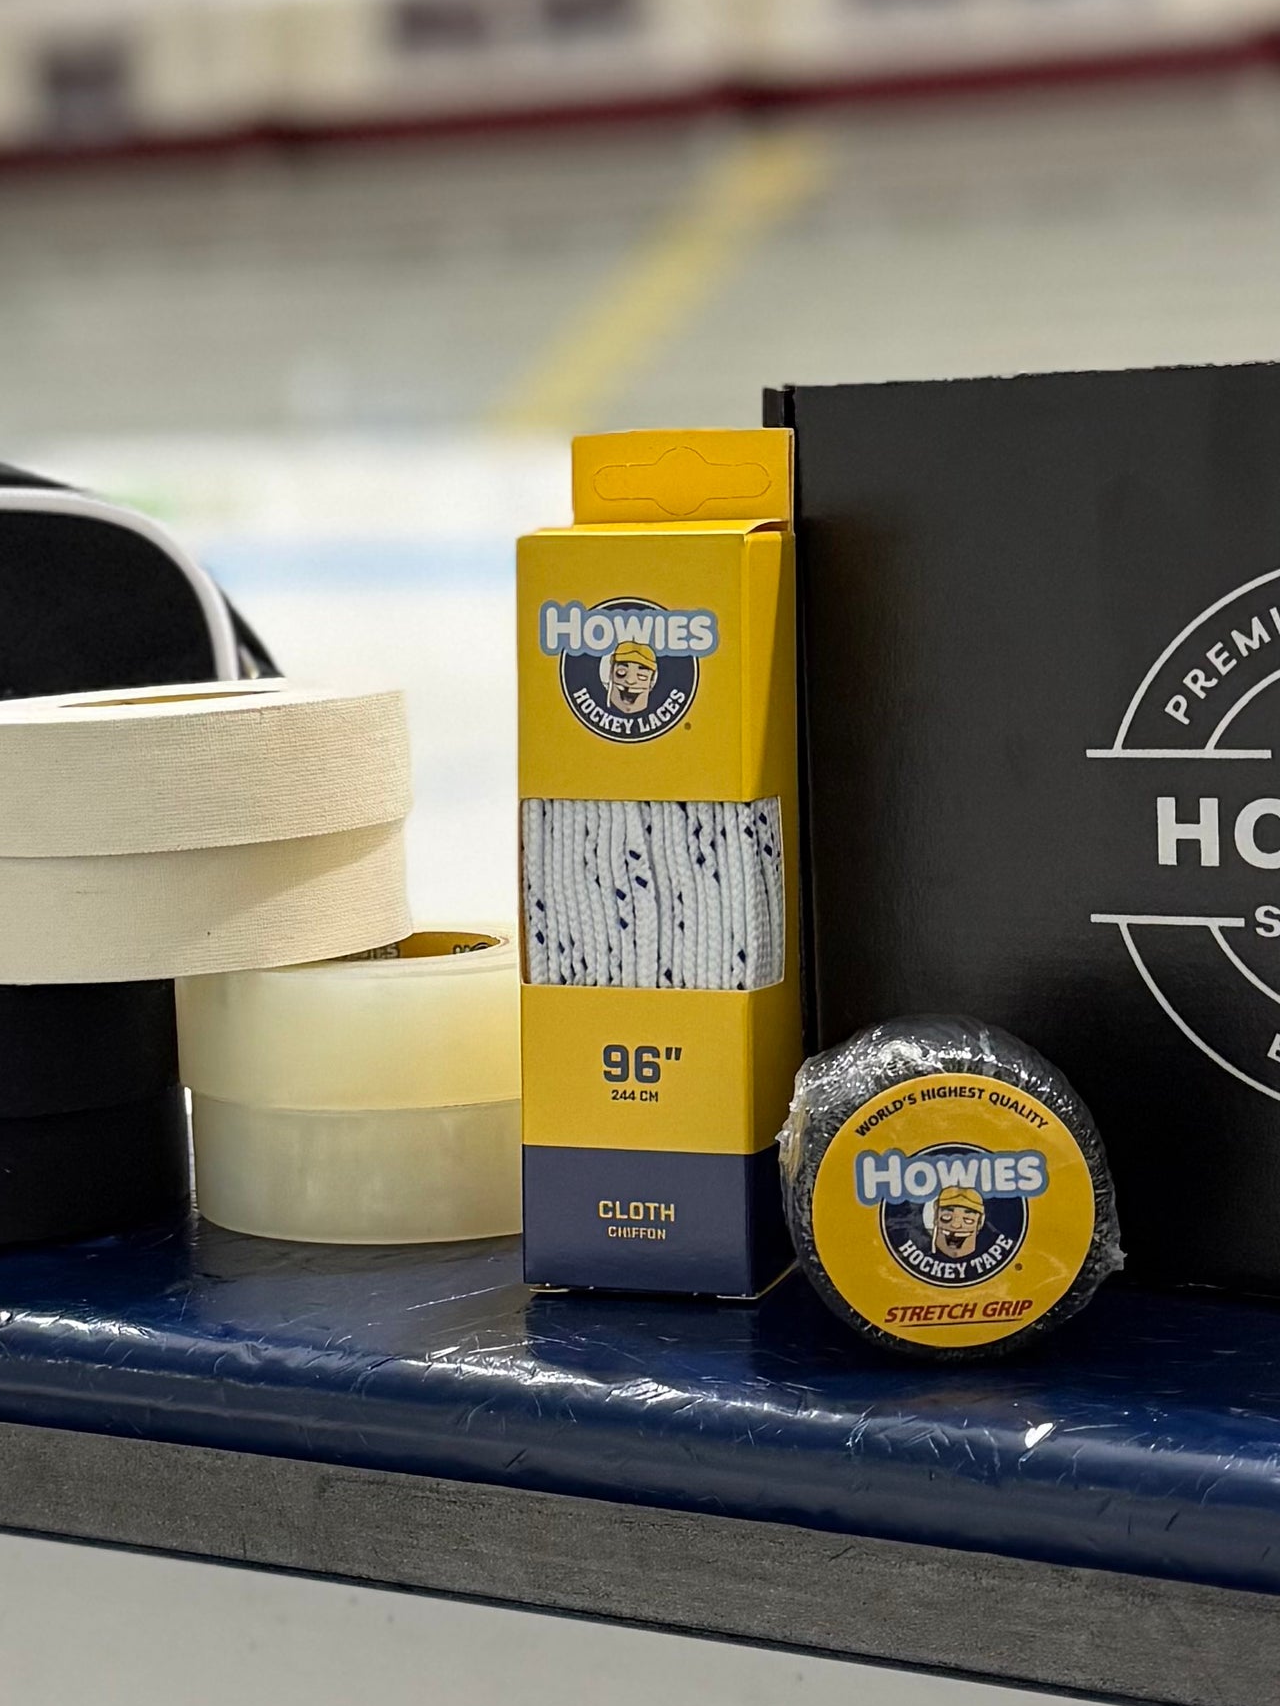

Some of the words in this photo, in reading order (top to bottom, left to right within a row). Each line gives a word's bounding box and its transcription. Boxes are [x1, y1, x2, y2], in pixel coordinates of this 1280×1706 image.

[546, 601, 713, 655] HOWIES
[573, 687, 634, 734] HOCKEY
[637, 688, 687, 733] LACES
[603, 1044, 682, 1083] 96"
[611, 1089, 636, 1101] 244
[640, 1090, 659, 1102] CM
[854, 1092, 918, 1137] WORLD'S
[920, 1086, 985, 1102] HIGHEST
[988, 1091, 1049, 1129] QUALITY
[862, 1152, 1044, 1200] HOWIES
[599, 1200, 675, 1222] CLOTH
[607, 1225, 667, 1240] CHIFFON
[898, 1239, 967, 1279] HOCKEY
[970, 1233, 1015, 1274] TAPE
[884, 1301, 977, 1324] STRETCH
[981, 1299, 1034, 1317] GRIP
